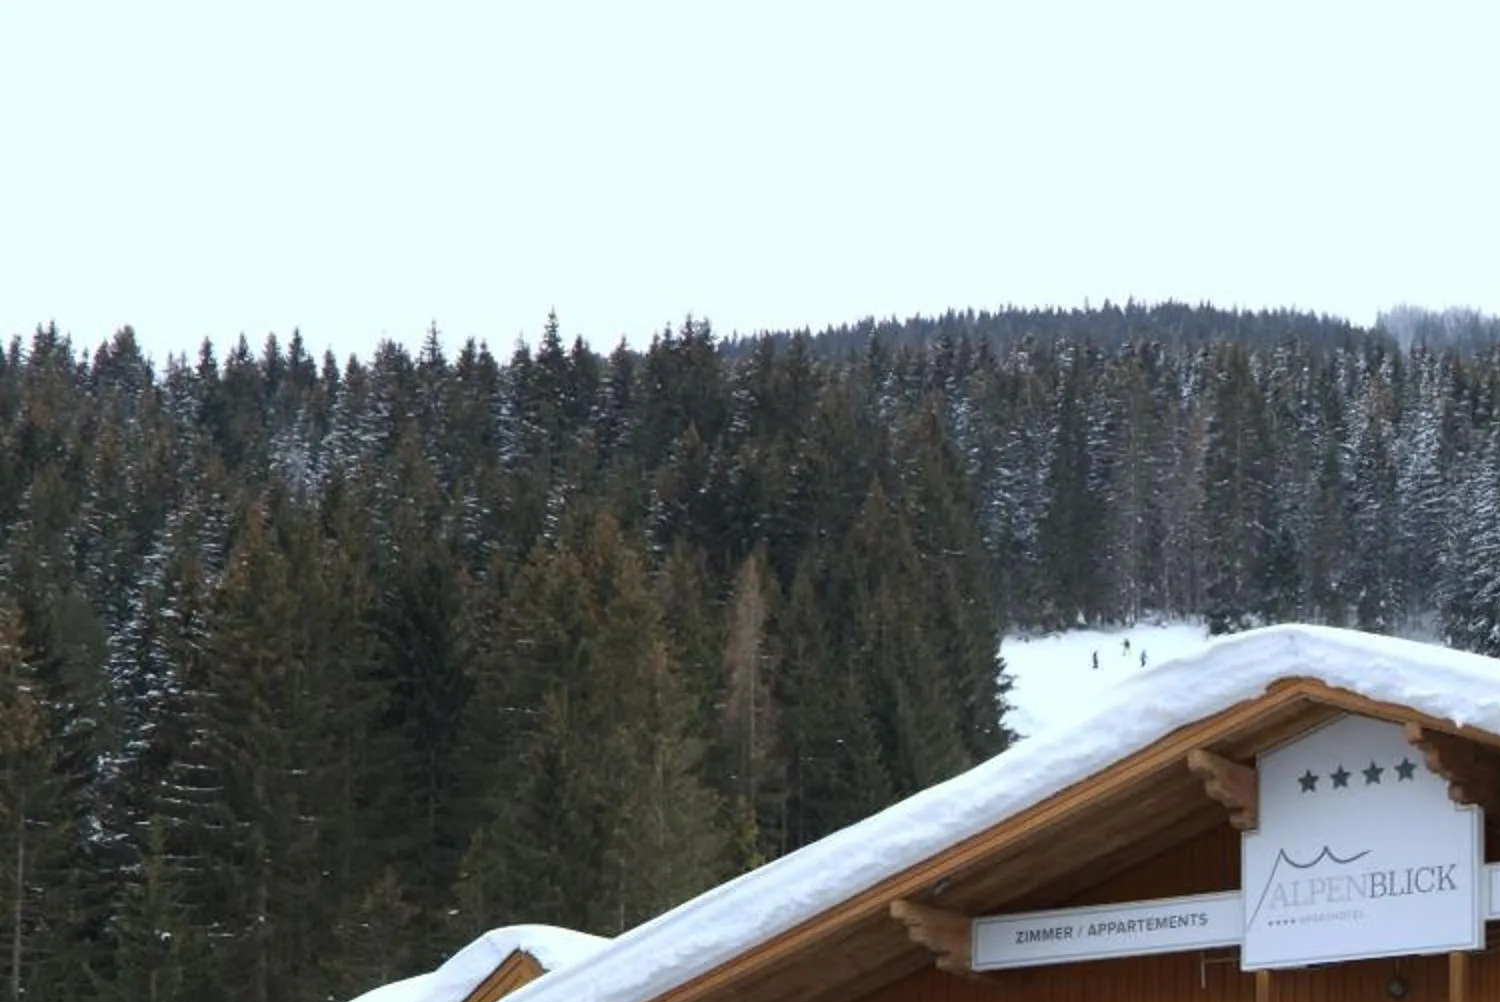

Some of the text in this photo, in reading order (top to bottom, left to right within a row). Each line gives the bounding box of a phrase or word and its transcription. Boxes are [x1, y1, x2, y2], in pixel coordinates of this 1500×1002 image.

[1269, 863, 1457, 909] ALPENBLICK
[1015, 926, 1073, 944] ZIMMER
[1087, 913, 1209, 936] APPARTEMENTS
